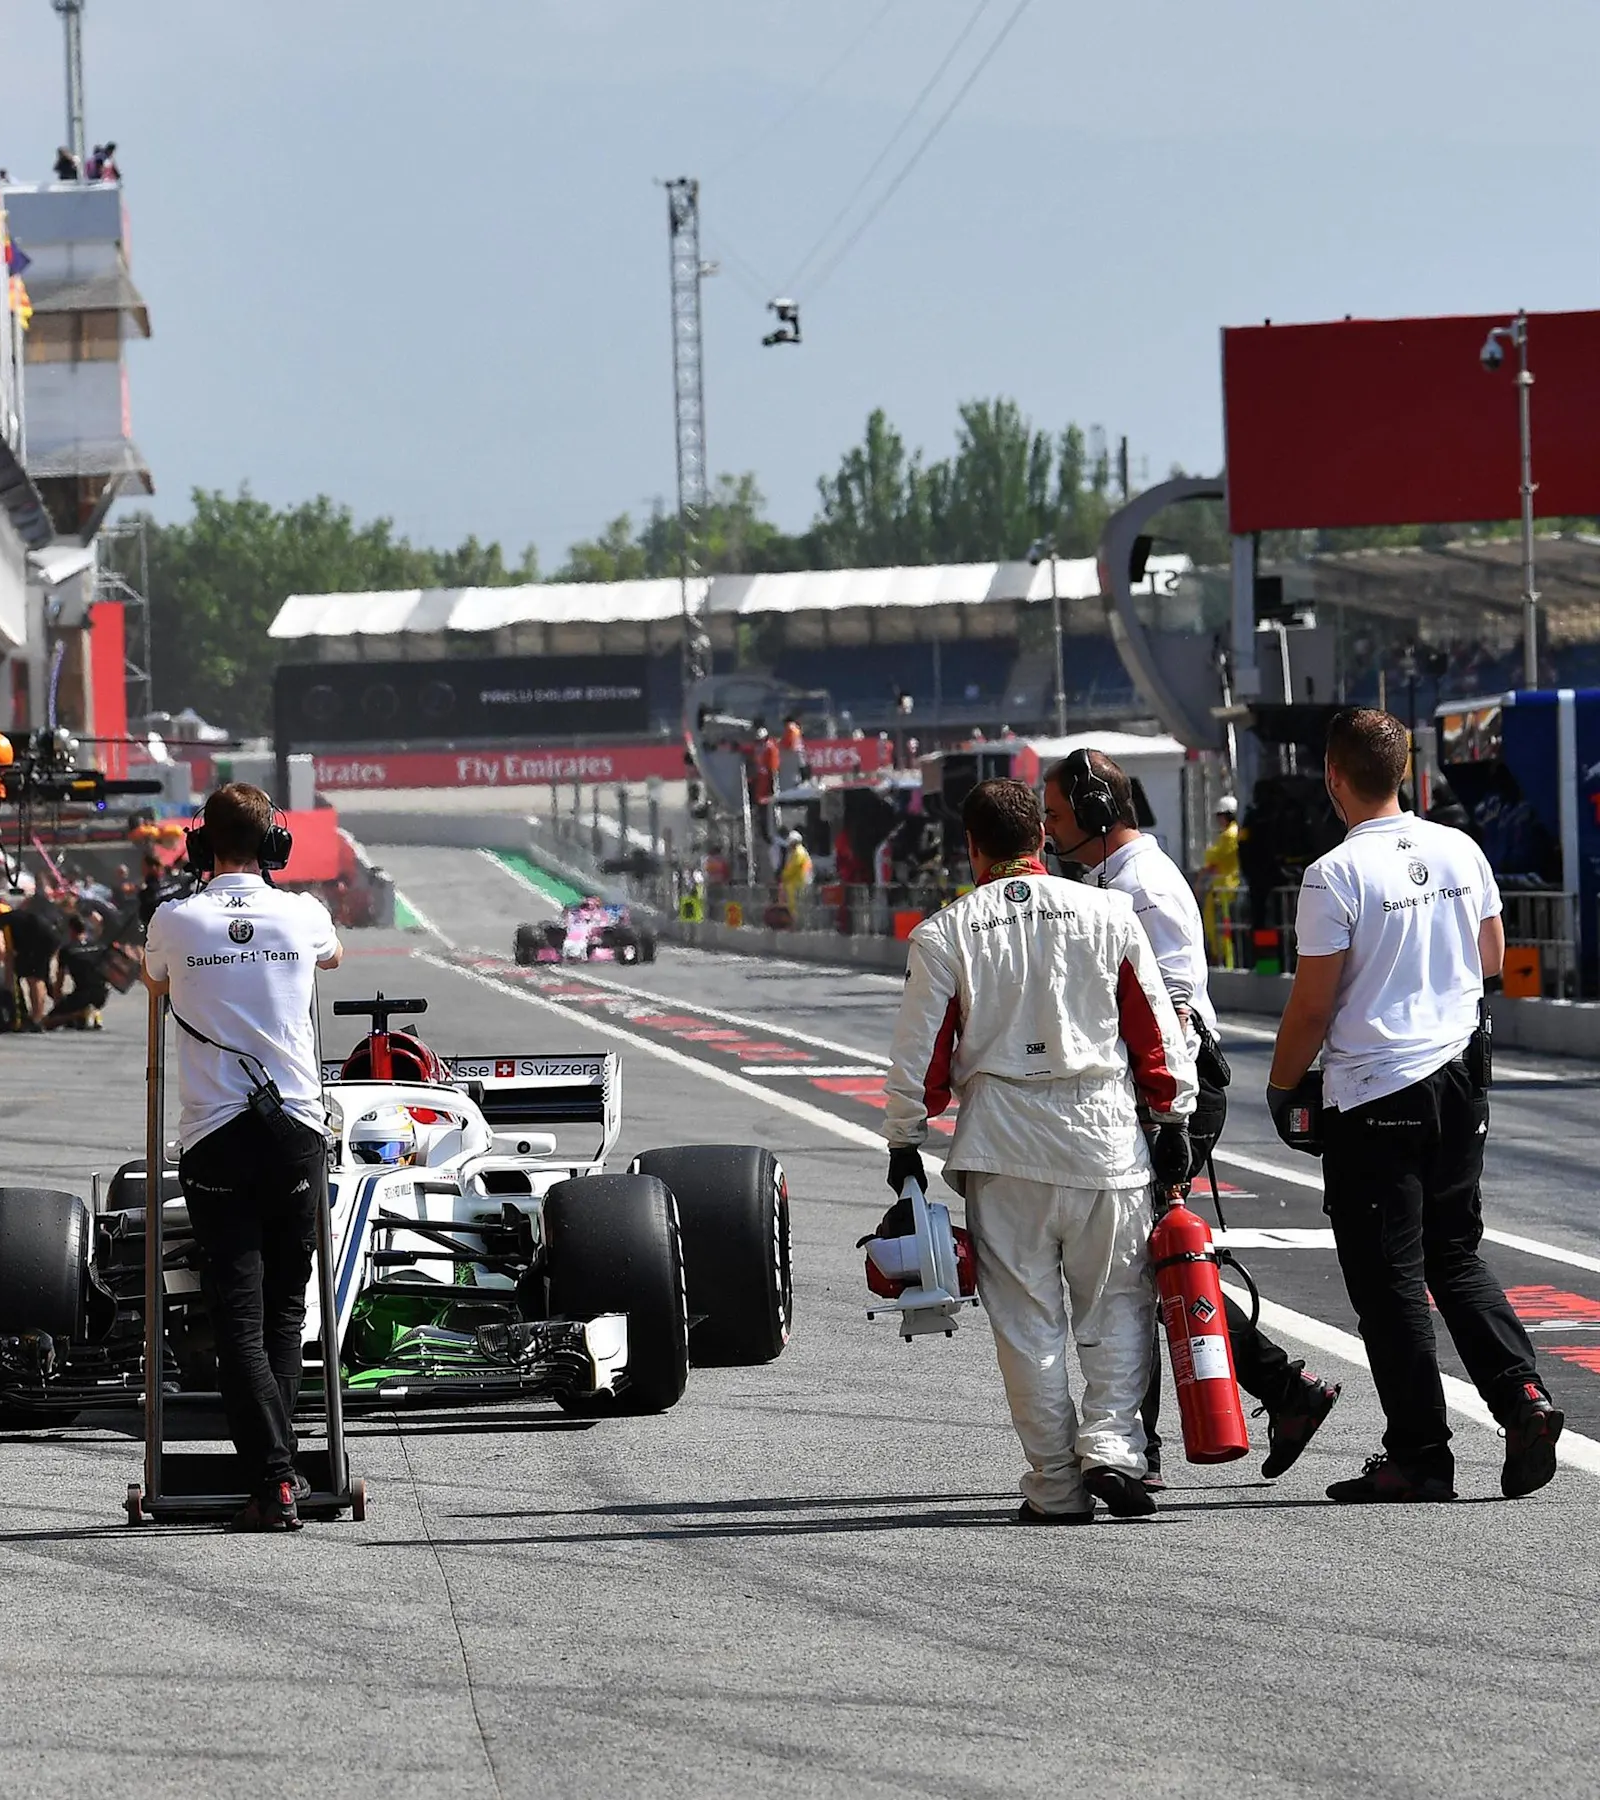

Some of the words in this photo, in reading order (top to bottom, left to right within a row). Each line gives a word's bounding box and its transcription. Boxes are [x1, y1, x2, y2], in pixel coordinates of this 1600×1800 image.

[318, 761, 386, 783] irates
[456, 757, 498, 785] Fly
[503, 755, 614, 779] Emirates
[810, 746, 862, 769] ates
[1439, 885, 1472, 900] Team
[970, 914, 1017, 933] Sauber
[1038, 908, 1076, 921] Team
[186, 954, 237, 968] Sauber
[263, 949, 300, 962] Team
[1025, 1041, 1047, 1055] OMP
[457, 1061, 490, 1077] sse
[520, 1059, 601, 1076] Svizzera
